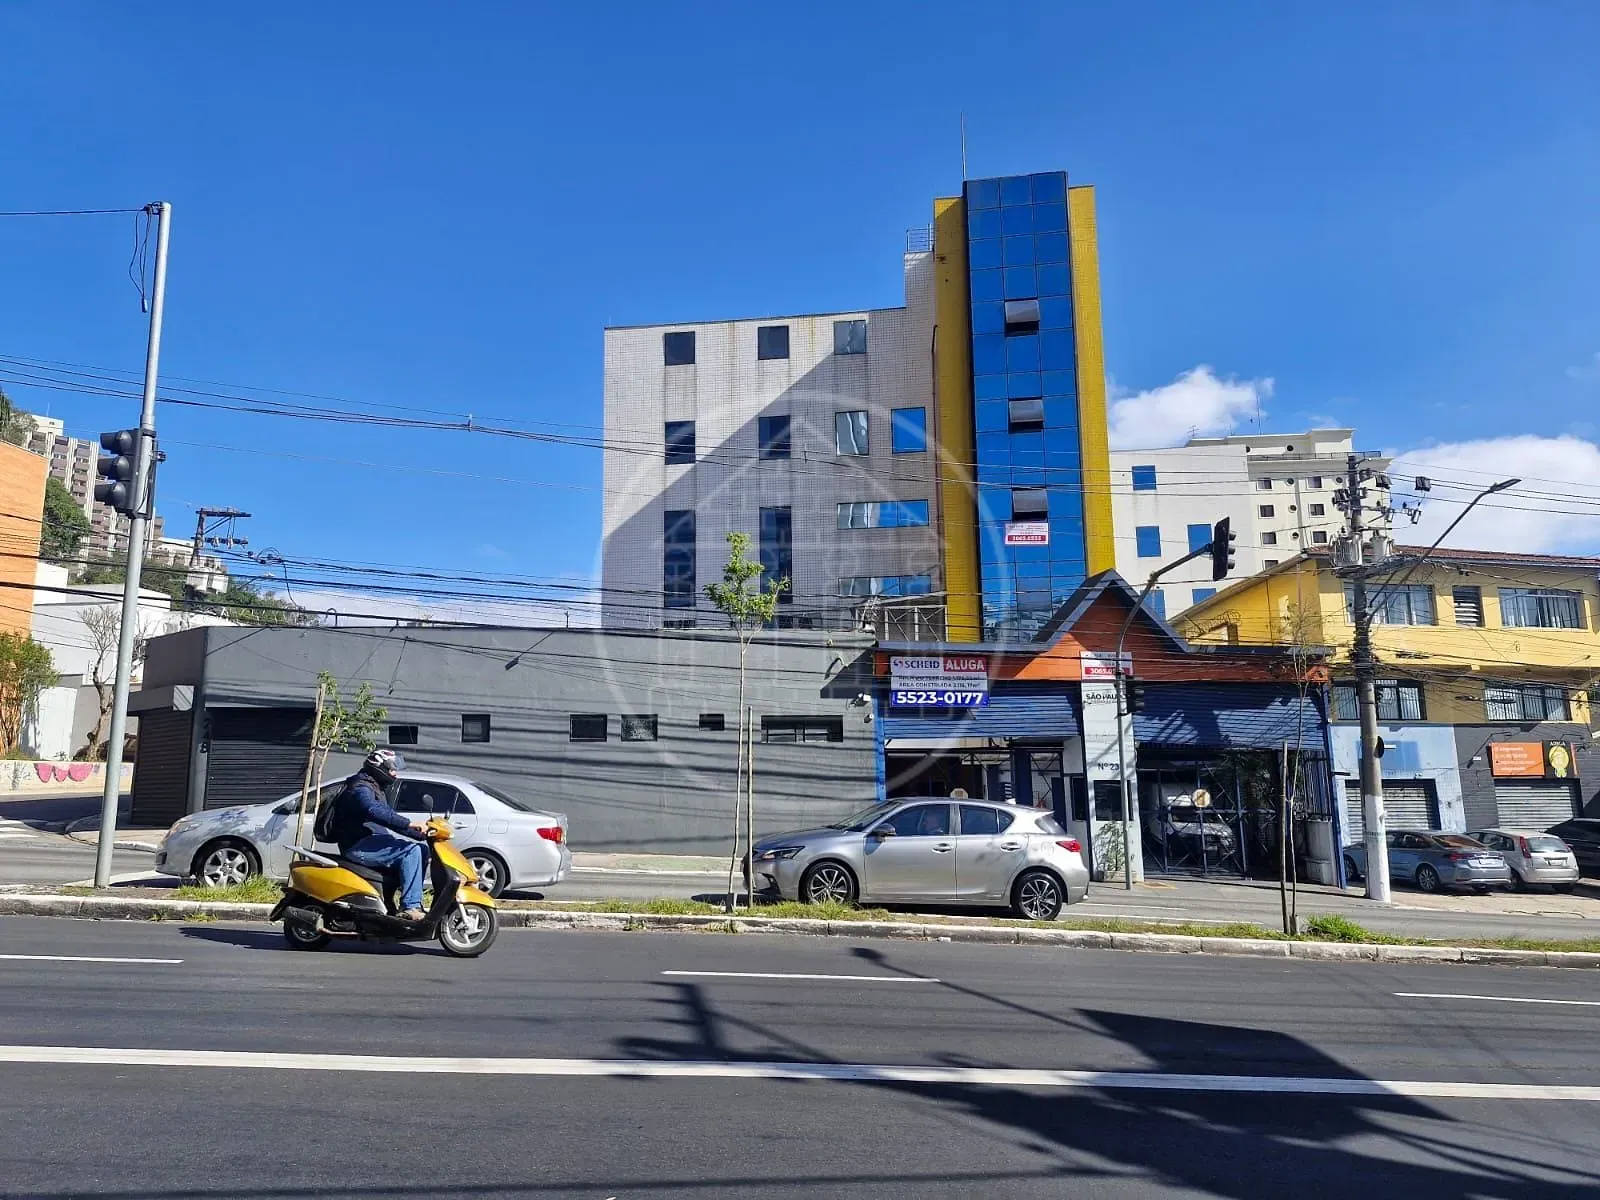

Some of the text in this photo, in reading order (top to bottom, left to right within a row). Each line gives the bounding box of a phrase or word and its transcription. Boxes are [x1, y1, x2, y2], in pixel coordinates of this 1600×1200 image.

[904, 660, 940, 669] SCHEID
[945, 659, 985, 670] ALUGA
[897, 691, 983, 704] 5523-0177
[1086, 692, 1102, 700] SÃO
